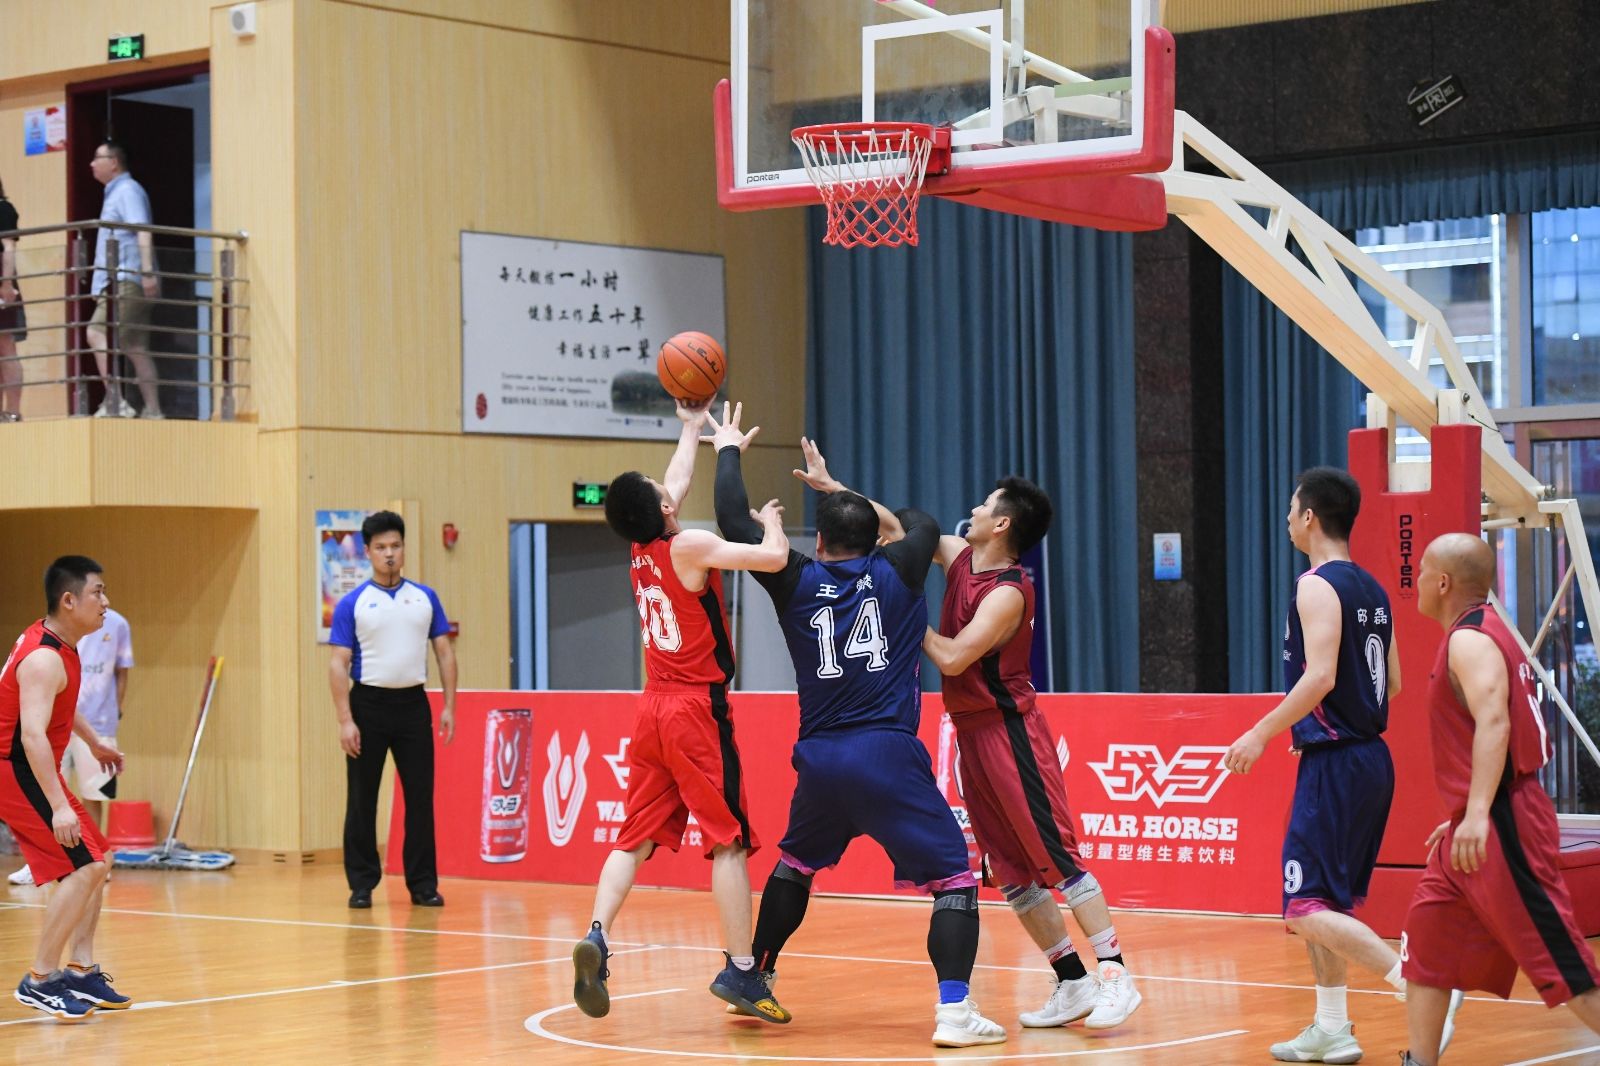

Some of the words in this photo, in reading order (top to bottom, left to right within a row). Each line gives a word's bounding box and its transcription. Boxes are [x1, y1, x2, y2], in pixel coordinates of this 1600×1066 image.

[809, 597, 889, 679] 14
[1364, 633, 1386, 709] 9
[596, 800, 628, 822] WA
[1080, 812, 1139, 838] WAR
[1142, 815, 1239, 841] HORSE
[1078, 841, 1236, 865] 能量型维生素饮料
[1284, 859, 1303, 894] 9
